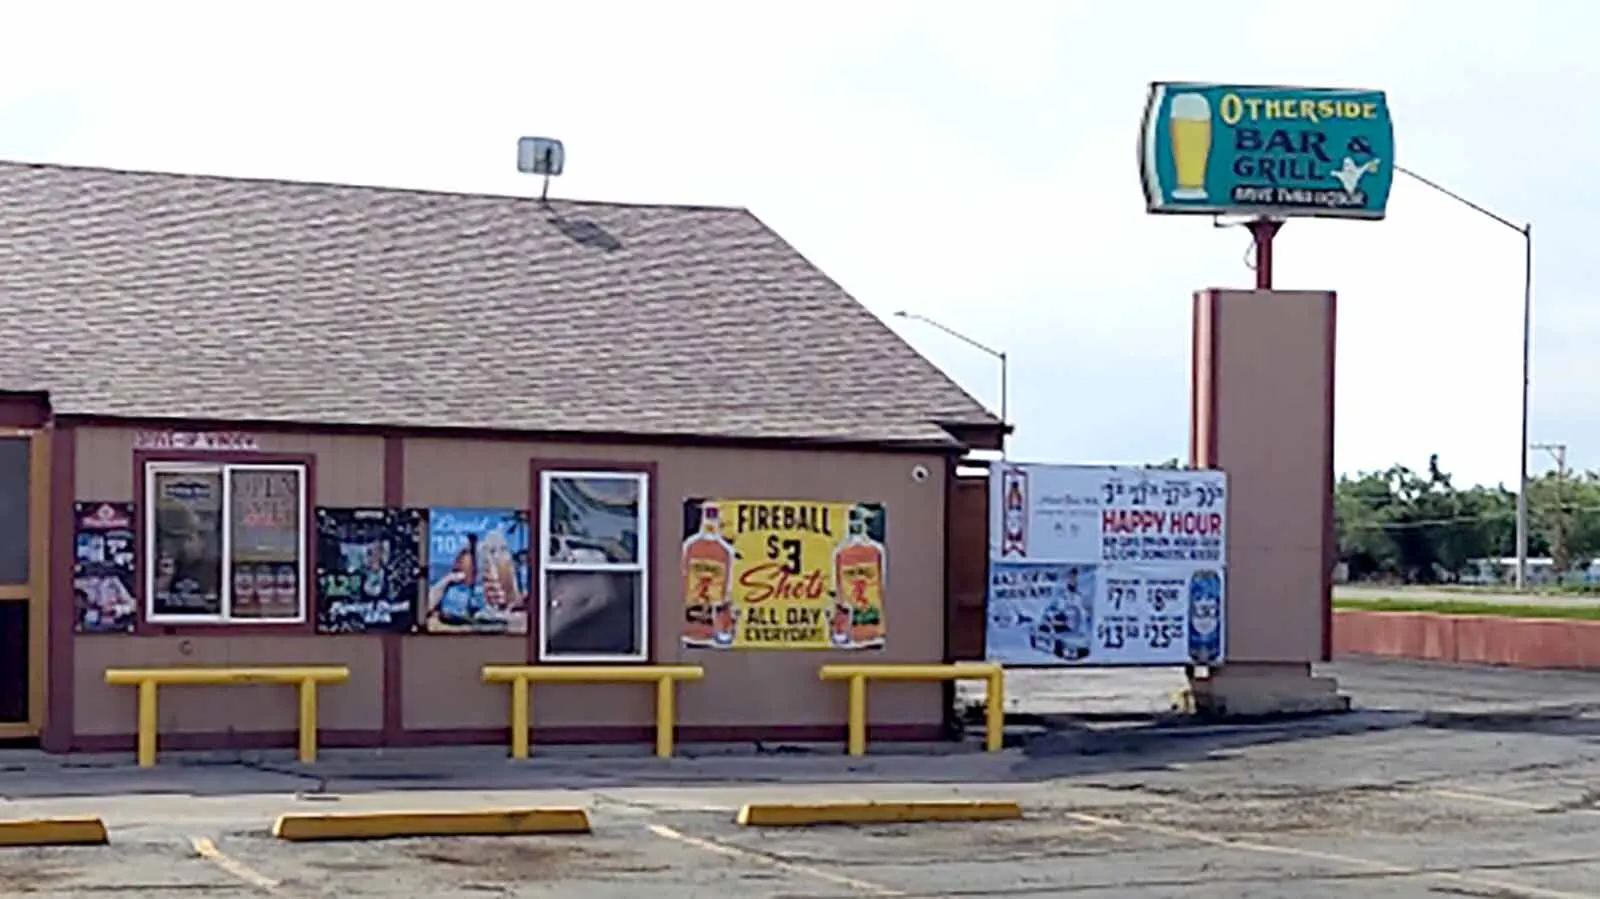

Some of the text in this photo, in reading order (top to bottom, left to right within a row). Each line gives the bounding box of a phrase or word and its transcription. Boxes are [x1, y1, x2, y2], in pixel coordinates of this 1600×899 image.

[1220, 93, 1378, 124] OTHERSIDE
[1234, 127, 1376, 163] BAR &
[1232, 155, 1325, 183] GRILL
[737, 504, 833, 536] FIREBALL
[1102, 509, 1222, 535] HAPPY HOUR
[739, 562, 826, 604] Shots
[746, 607, 822, 625] ALL DAY
